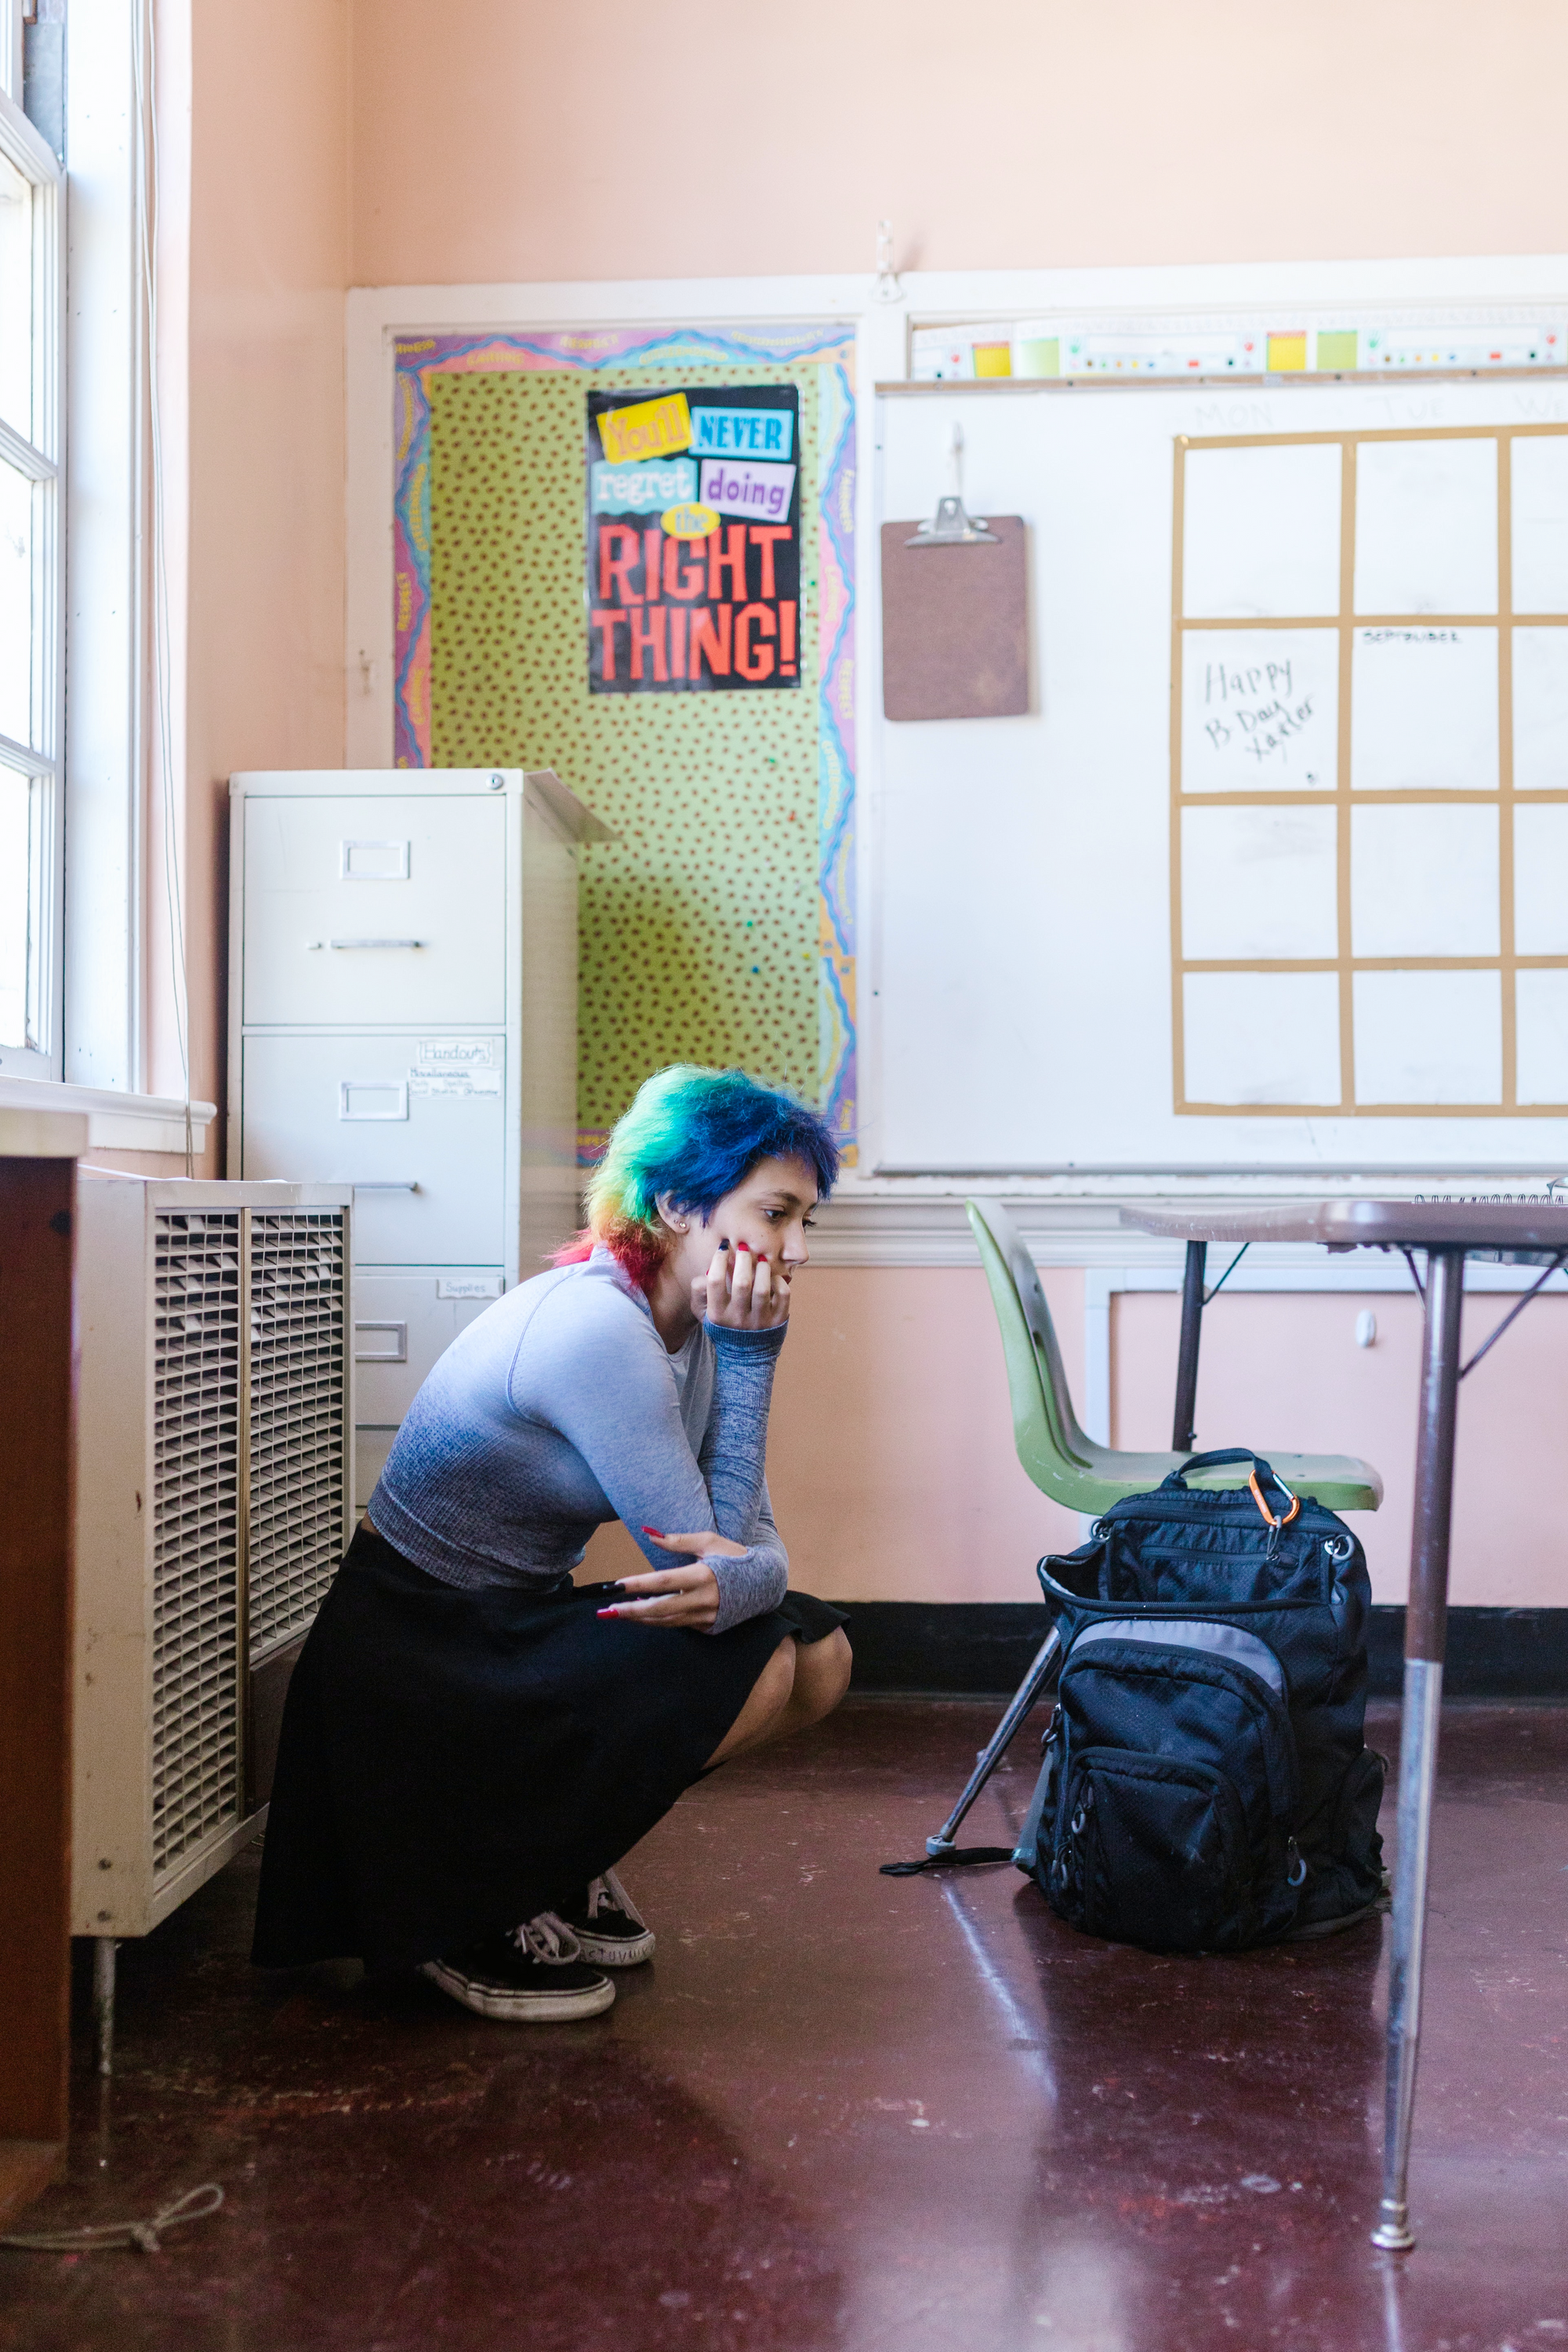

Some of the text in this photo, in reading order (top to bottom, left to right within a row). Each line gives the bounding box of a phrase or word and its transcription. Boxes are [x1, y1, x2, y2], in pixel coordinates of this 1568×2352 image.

[607, 402, 782, 457] You'll NEVER
[1193, 400, 1274, 430] MON
[596, 465, 786, 514] regret doing
[674, 506, 709, 534] the
[598, 524, 793, 605] RIGHT
[591, 601, 797, 681] THING!
[1205, 659, 1292, 705] Happy
[423, 1043, 486, 1061] Handouts
[445, 1281, 486, 1295] Supplies
